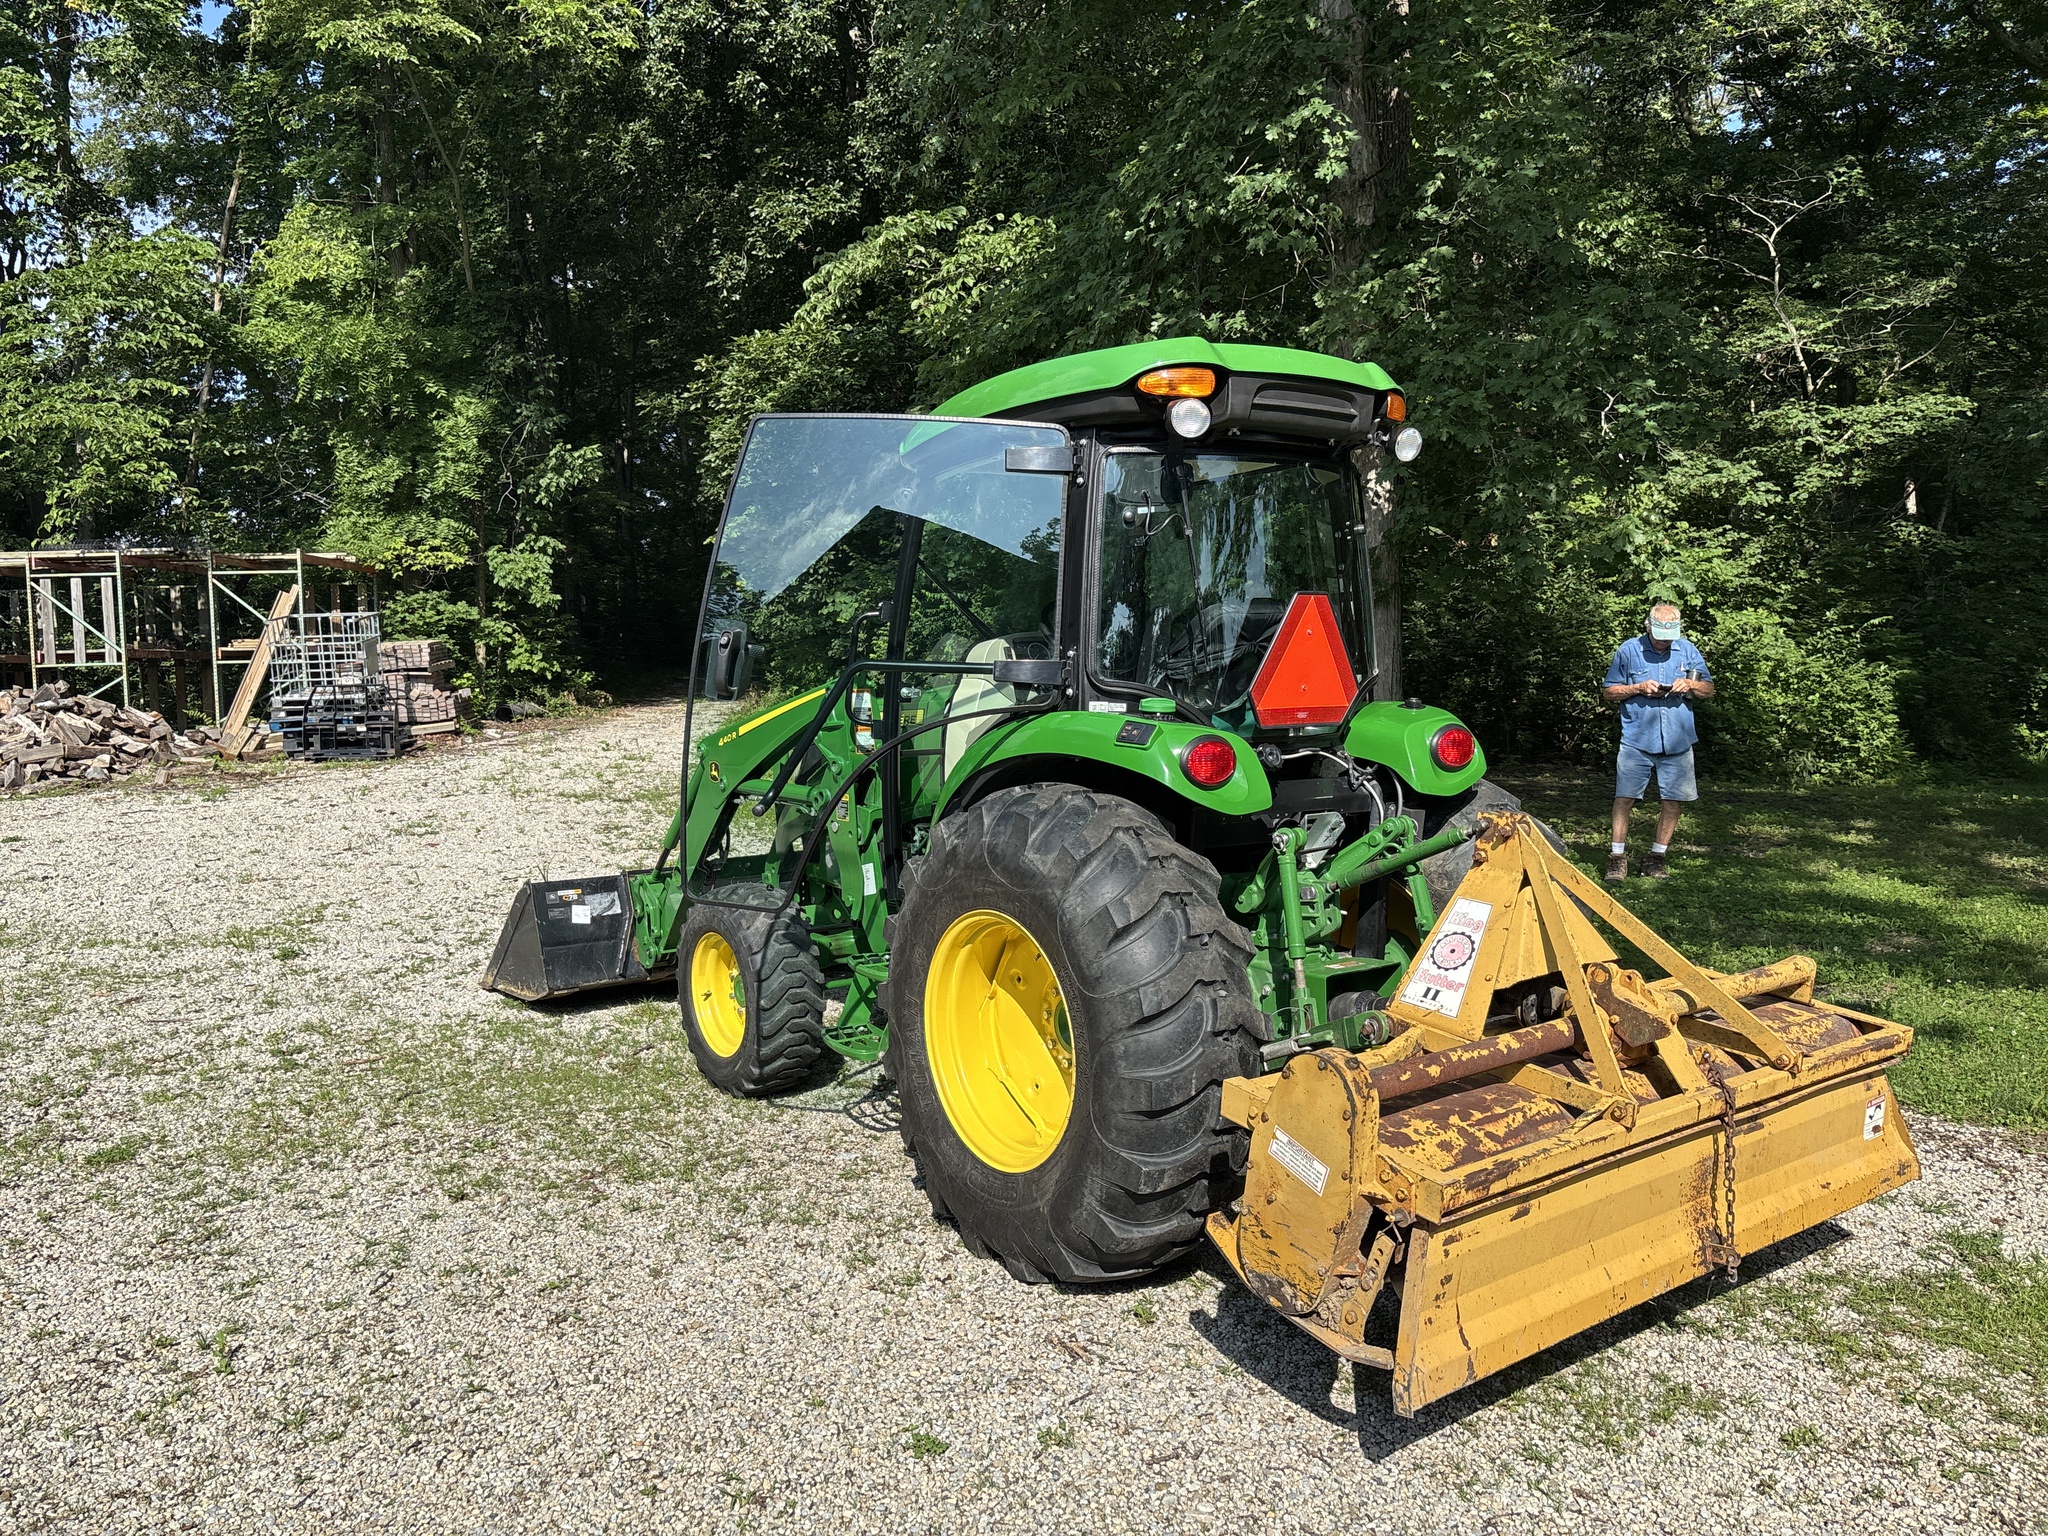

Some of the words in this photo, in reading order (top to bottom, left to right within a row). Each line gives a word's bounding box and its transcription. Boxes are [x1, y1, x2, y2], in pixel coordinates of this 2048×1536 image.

[1448, 911, 1485, 933] King
[1414, 968, 1465, 992] Kutter
[904, 989, 935, 1113] TITAN
